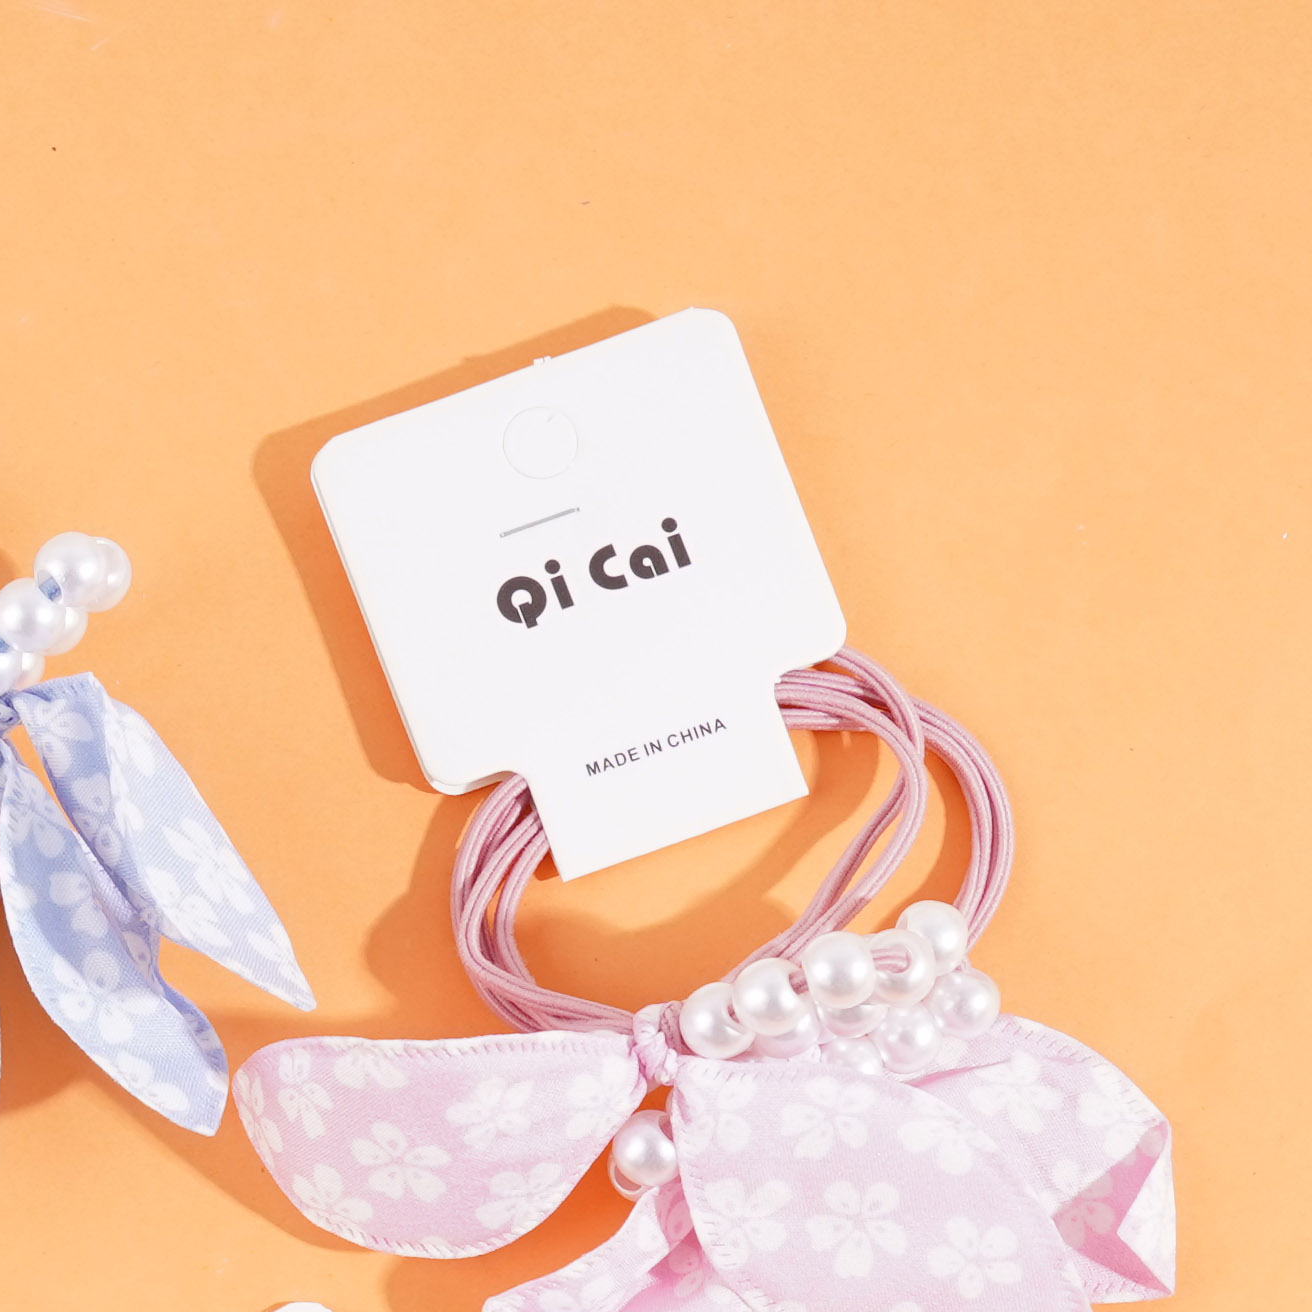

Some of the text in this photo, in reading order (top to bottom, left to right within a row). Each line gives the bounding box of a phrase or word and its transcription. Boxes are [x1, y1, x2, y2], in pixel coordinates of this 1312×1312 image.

[496, 517, 692, 629] Qi Cai
[585, 718, 727, 776] MADE IN CHINA
